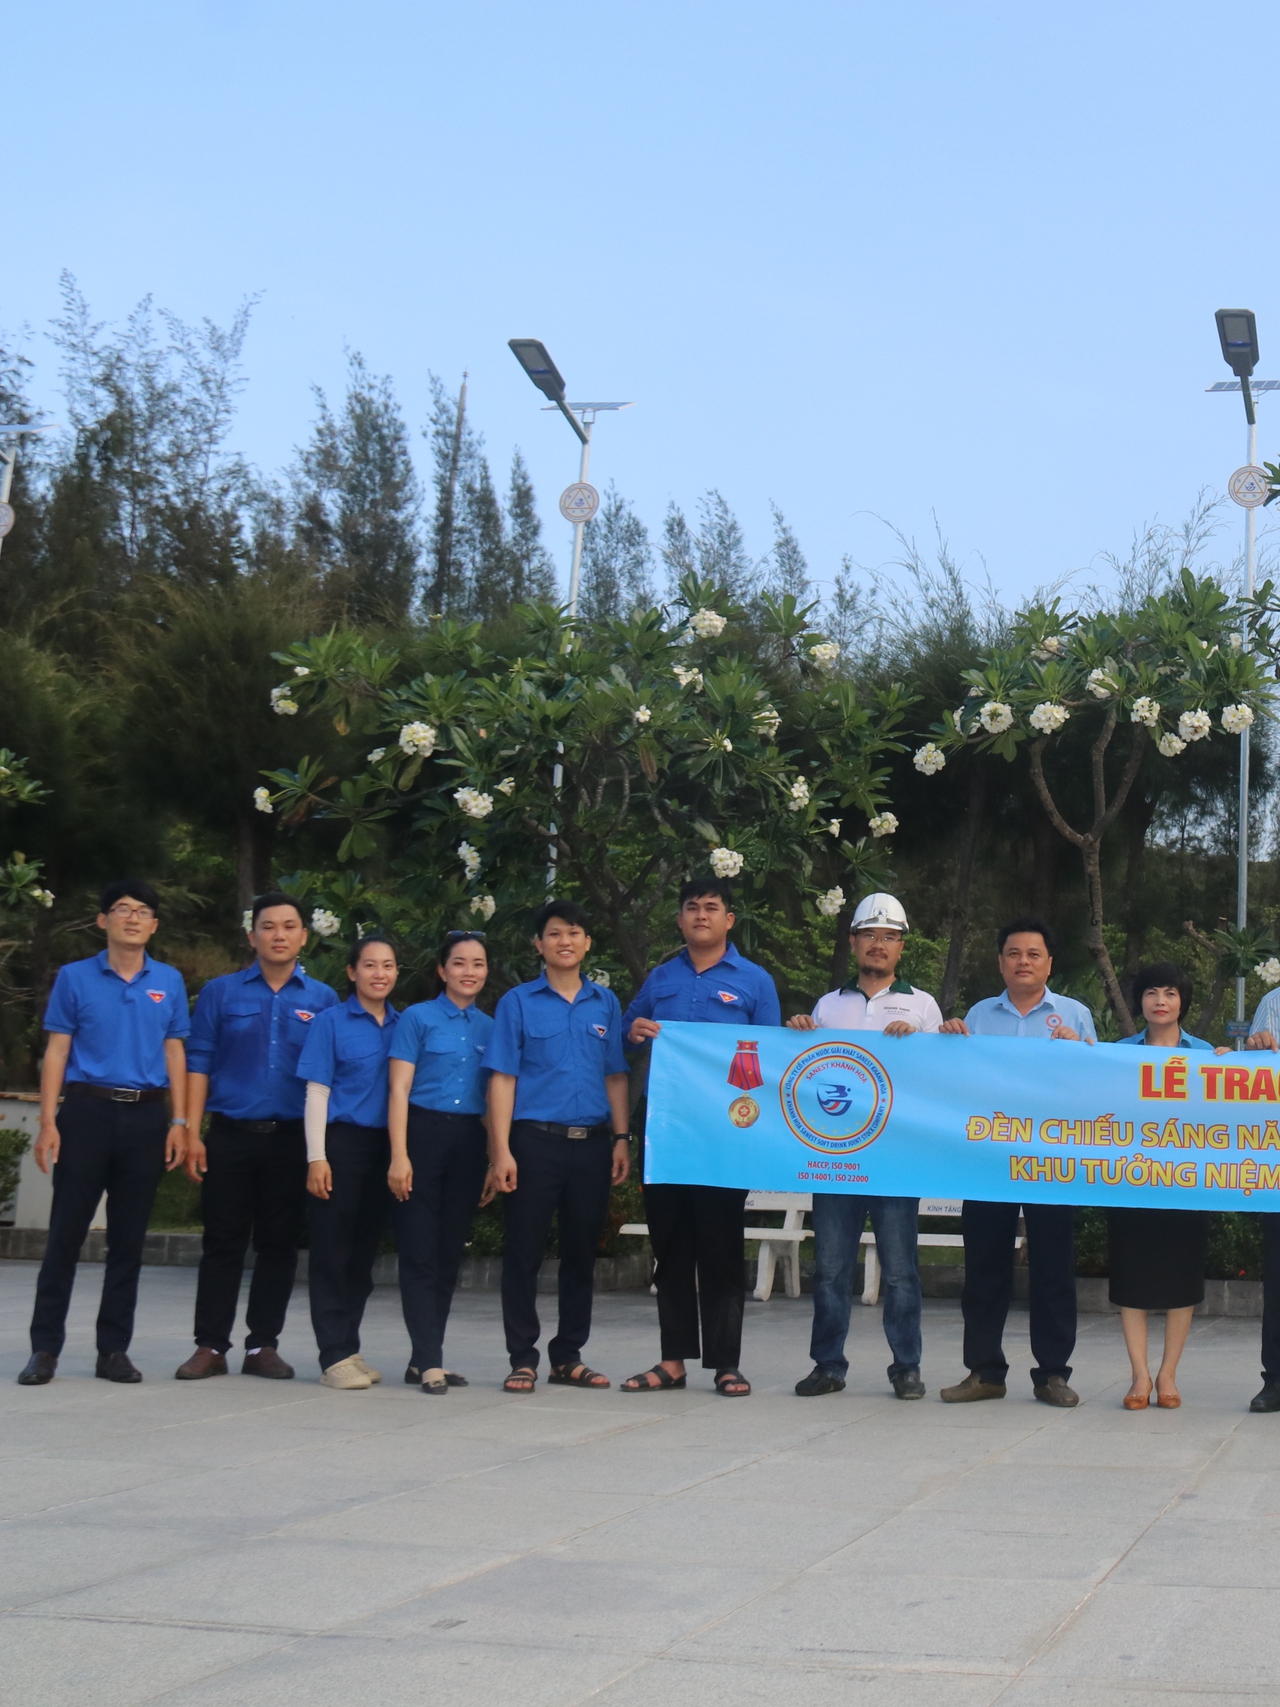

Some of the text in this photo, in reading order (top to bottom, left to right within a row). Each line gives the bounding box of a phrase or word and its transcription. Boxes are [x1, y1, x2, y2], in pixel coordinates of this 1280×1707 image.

[785, 1076, 794, 1090] CÔNG
[791, 1069, 799, 1077] TY
[856, 1052, 873, 1067] SANEST
[806, 1063, 829, 1081] SANEST
[830, 1062, 856, 1072] KHÁNH
[1139, 1056, 1189, 1100] LỄ
[799, 1127, 818, 1142] SANEST
[816, 1138, 831, 1147] SOFT
[848, 1136, 862, 1147] JOINT
[861, 1127, 875, 1141] STOCK
[871, 1105, 885, 1129] COMPANY
[966, 1111, 1033, 1143] ĐÈN
[1039, 1113, 1134, 1147] CHIẾU
[1140, 1118, 1230, 1150] SÁNG
[798, 1172, 869, 1183] ISO 14001, ISO 22000
[807, 1161, 861, 1171] HACCP, ISO 9001
[1009, 1154, 1077, 1183] KHU
[1080, 1153, 1198, 1188] TƯỞNG
